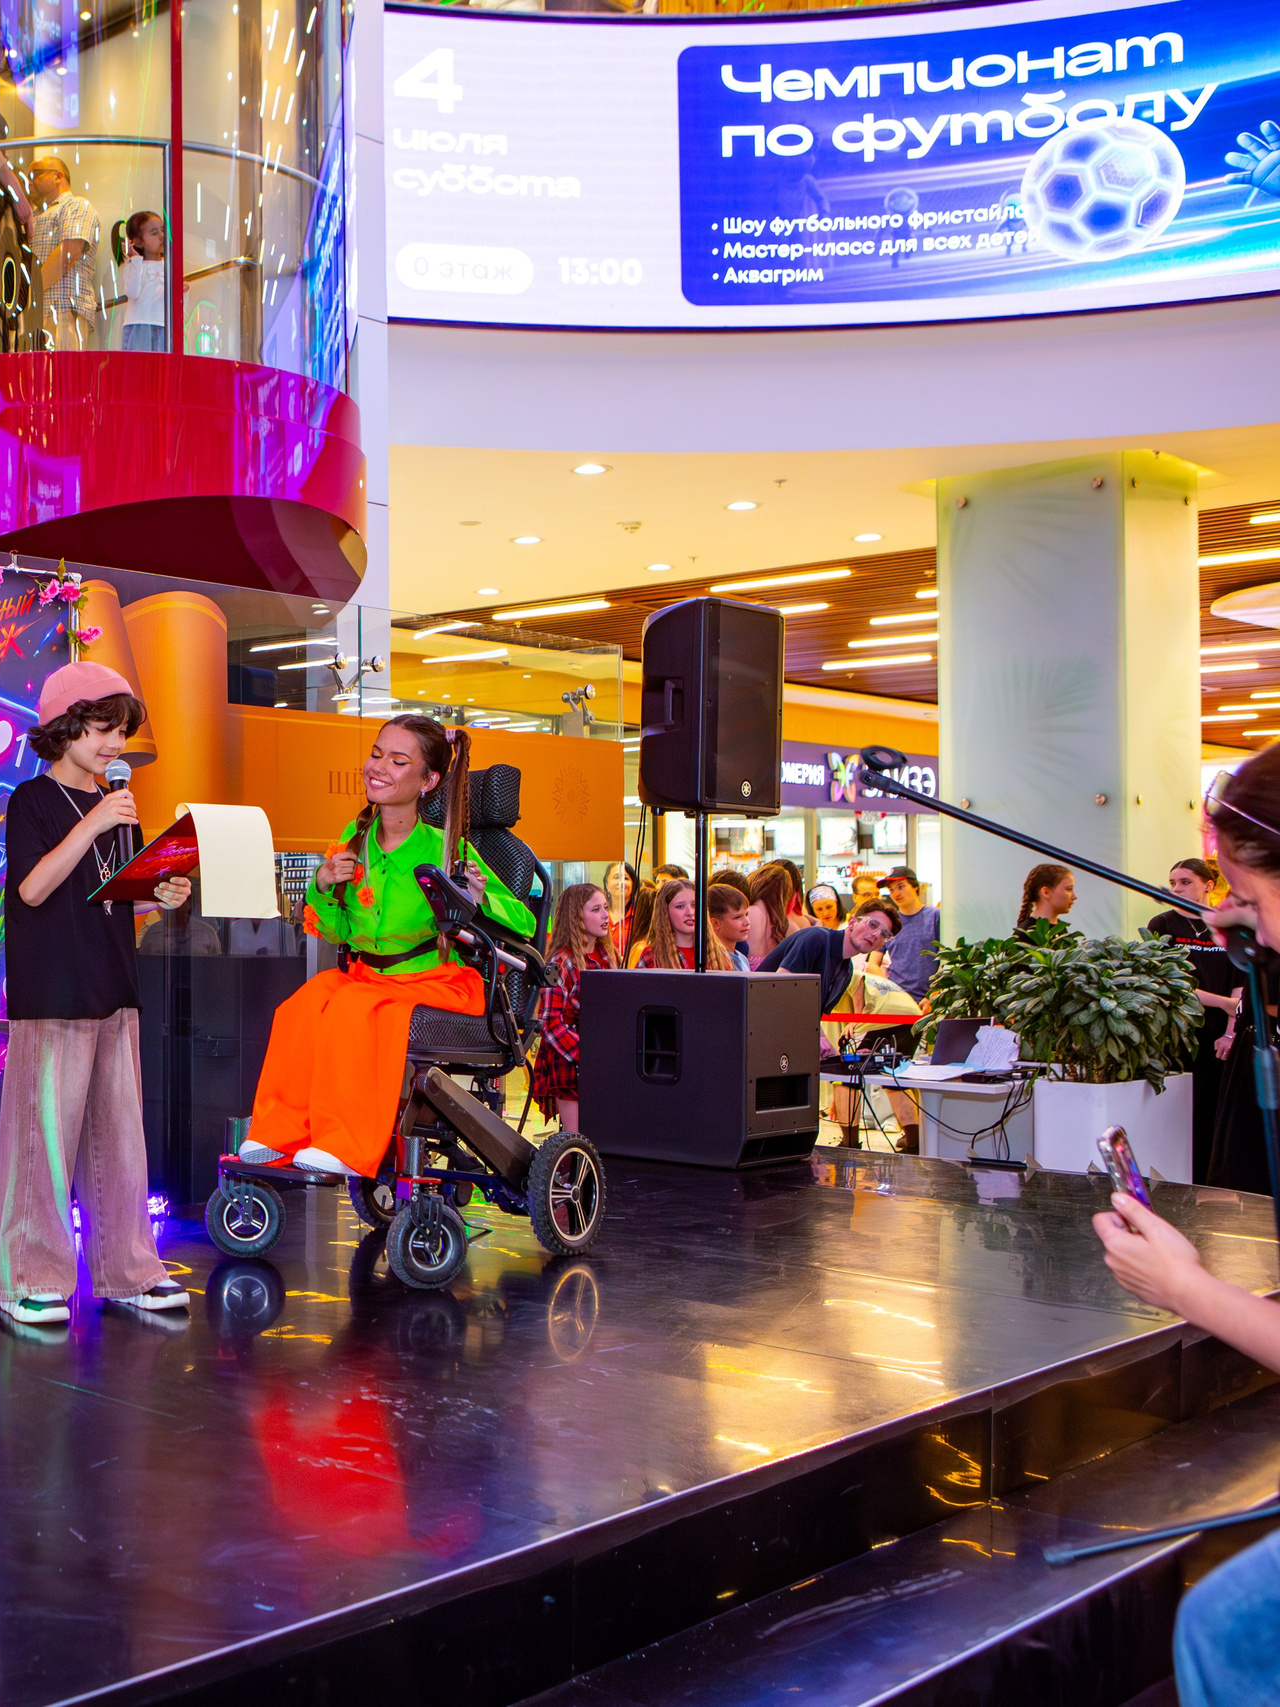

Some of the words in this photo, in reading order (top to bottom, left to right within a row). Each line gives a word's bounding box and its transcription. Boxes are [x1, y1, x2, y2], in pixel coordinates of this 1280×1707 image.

[393, 48, 463, 114] 4
[721, 31, 1184, 103] Чемпионат
[721, 123, 813, 158] по
[832, 83, 1219, 163] футболу
[393, 127, 508, 156] июля
[393, 162, 581, 198] суббота
[723, 217, 766, 237] Шоу
[770, 213, 903, 236] футбольного
[908, 203, 1029, 230] фристайла
[723, 238, 875, 260] Мастер-класс
[879, 236, 918, 256] для
[923, 232, 972, 251] всех
[975, 227, 1041, 249] детей
[439, 261, 514, 281] этаж
[558, 257, 643, 286] 13:00
[723, 267, 824, 286] Аквагрим
